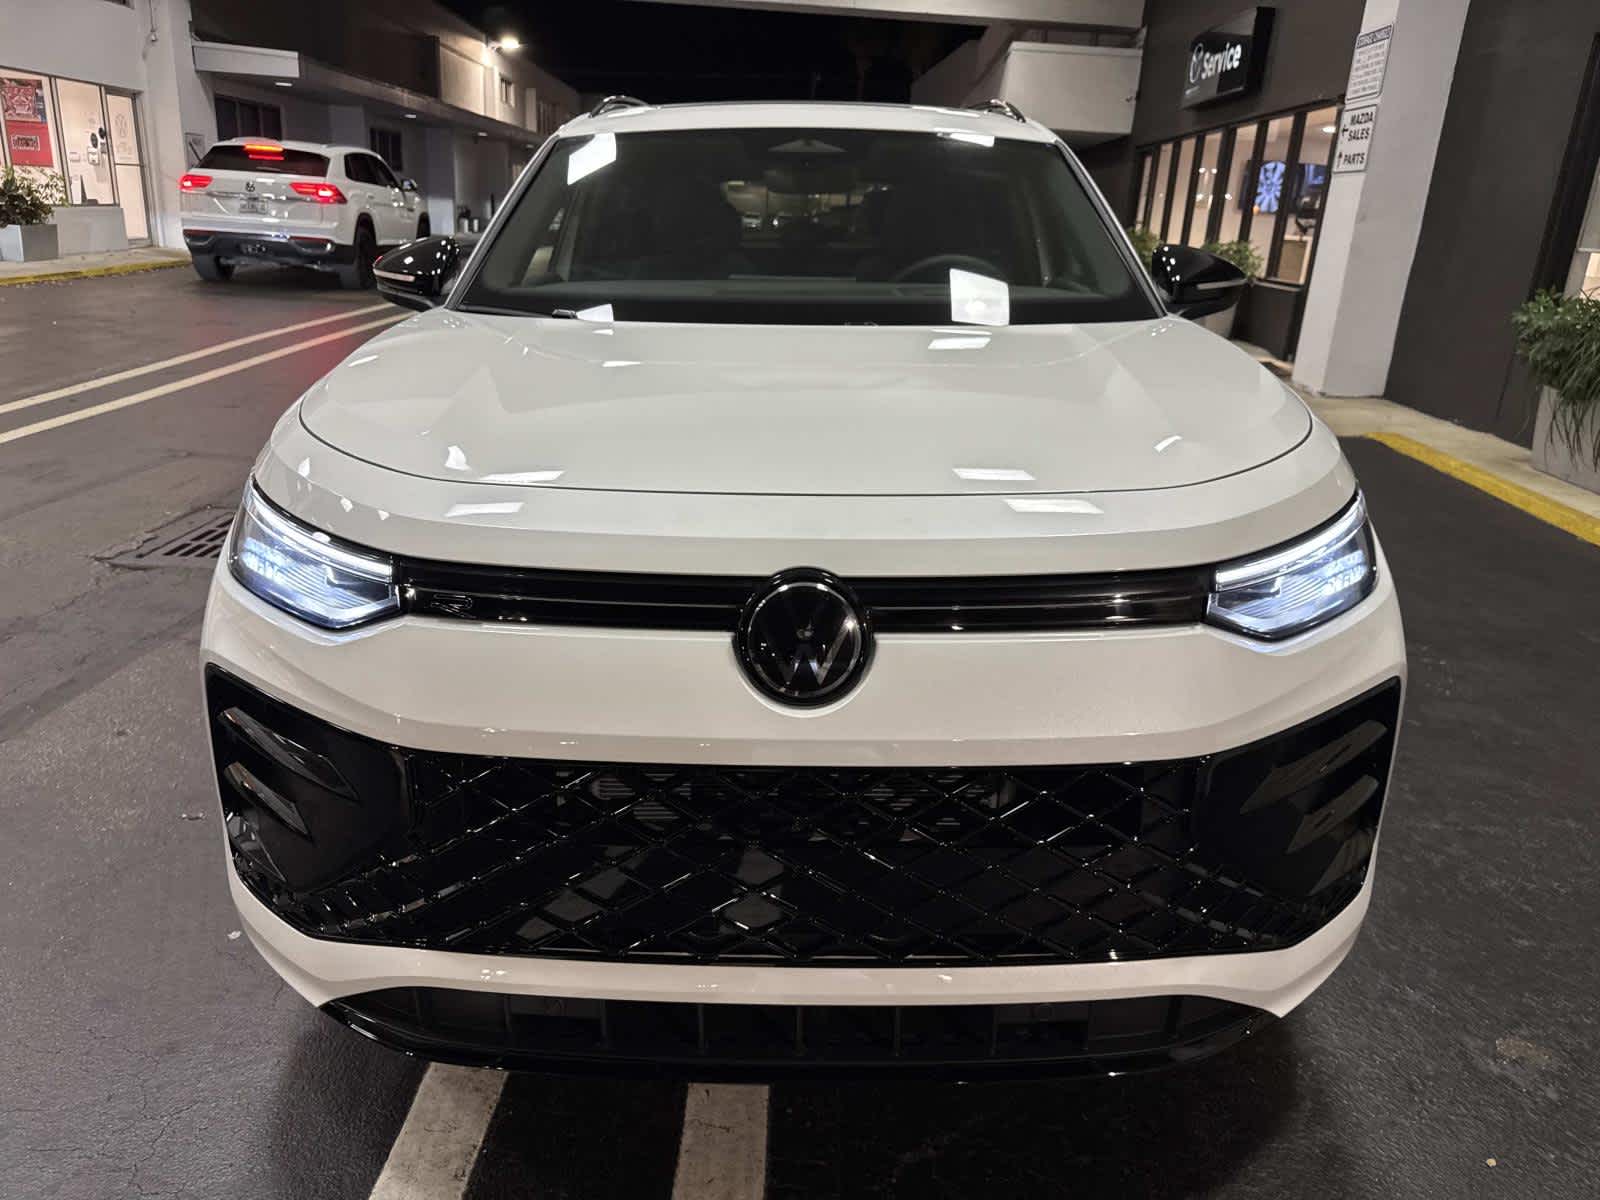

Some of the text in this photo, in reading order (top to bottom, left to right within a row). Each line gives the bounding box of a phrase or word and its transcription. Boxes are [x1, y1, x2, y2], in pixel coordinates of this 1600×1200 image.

[1201, 42, 1242, 80] Service
[1350, 111, 1374, 126] MAZDA
[1347, 127, 1370, 142] SALES
[1342, 152, 1365, 166] PARTS
